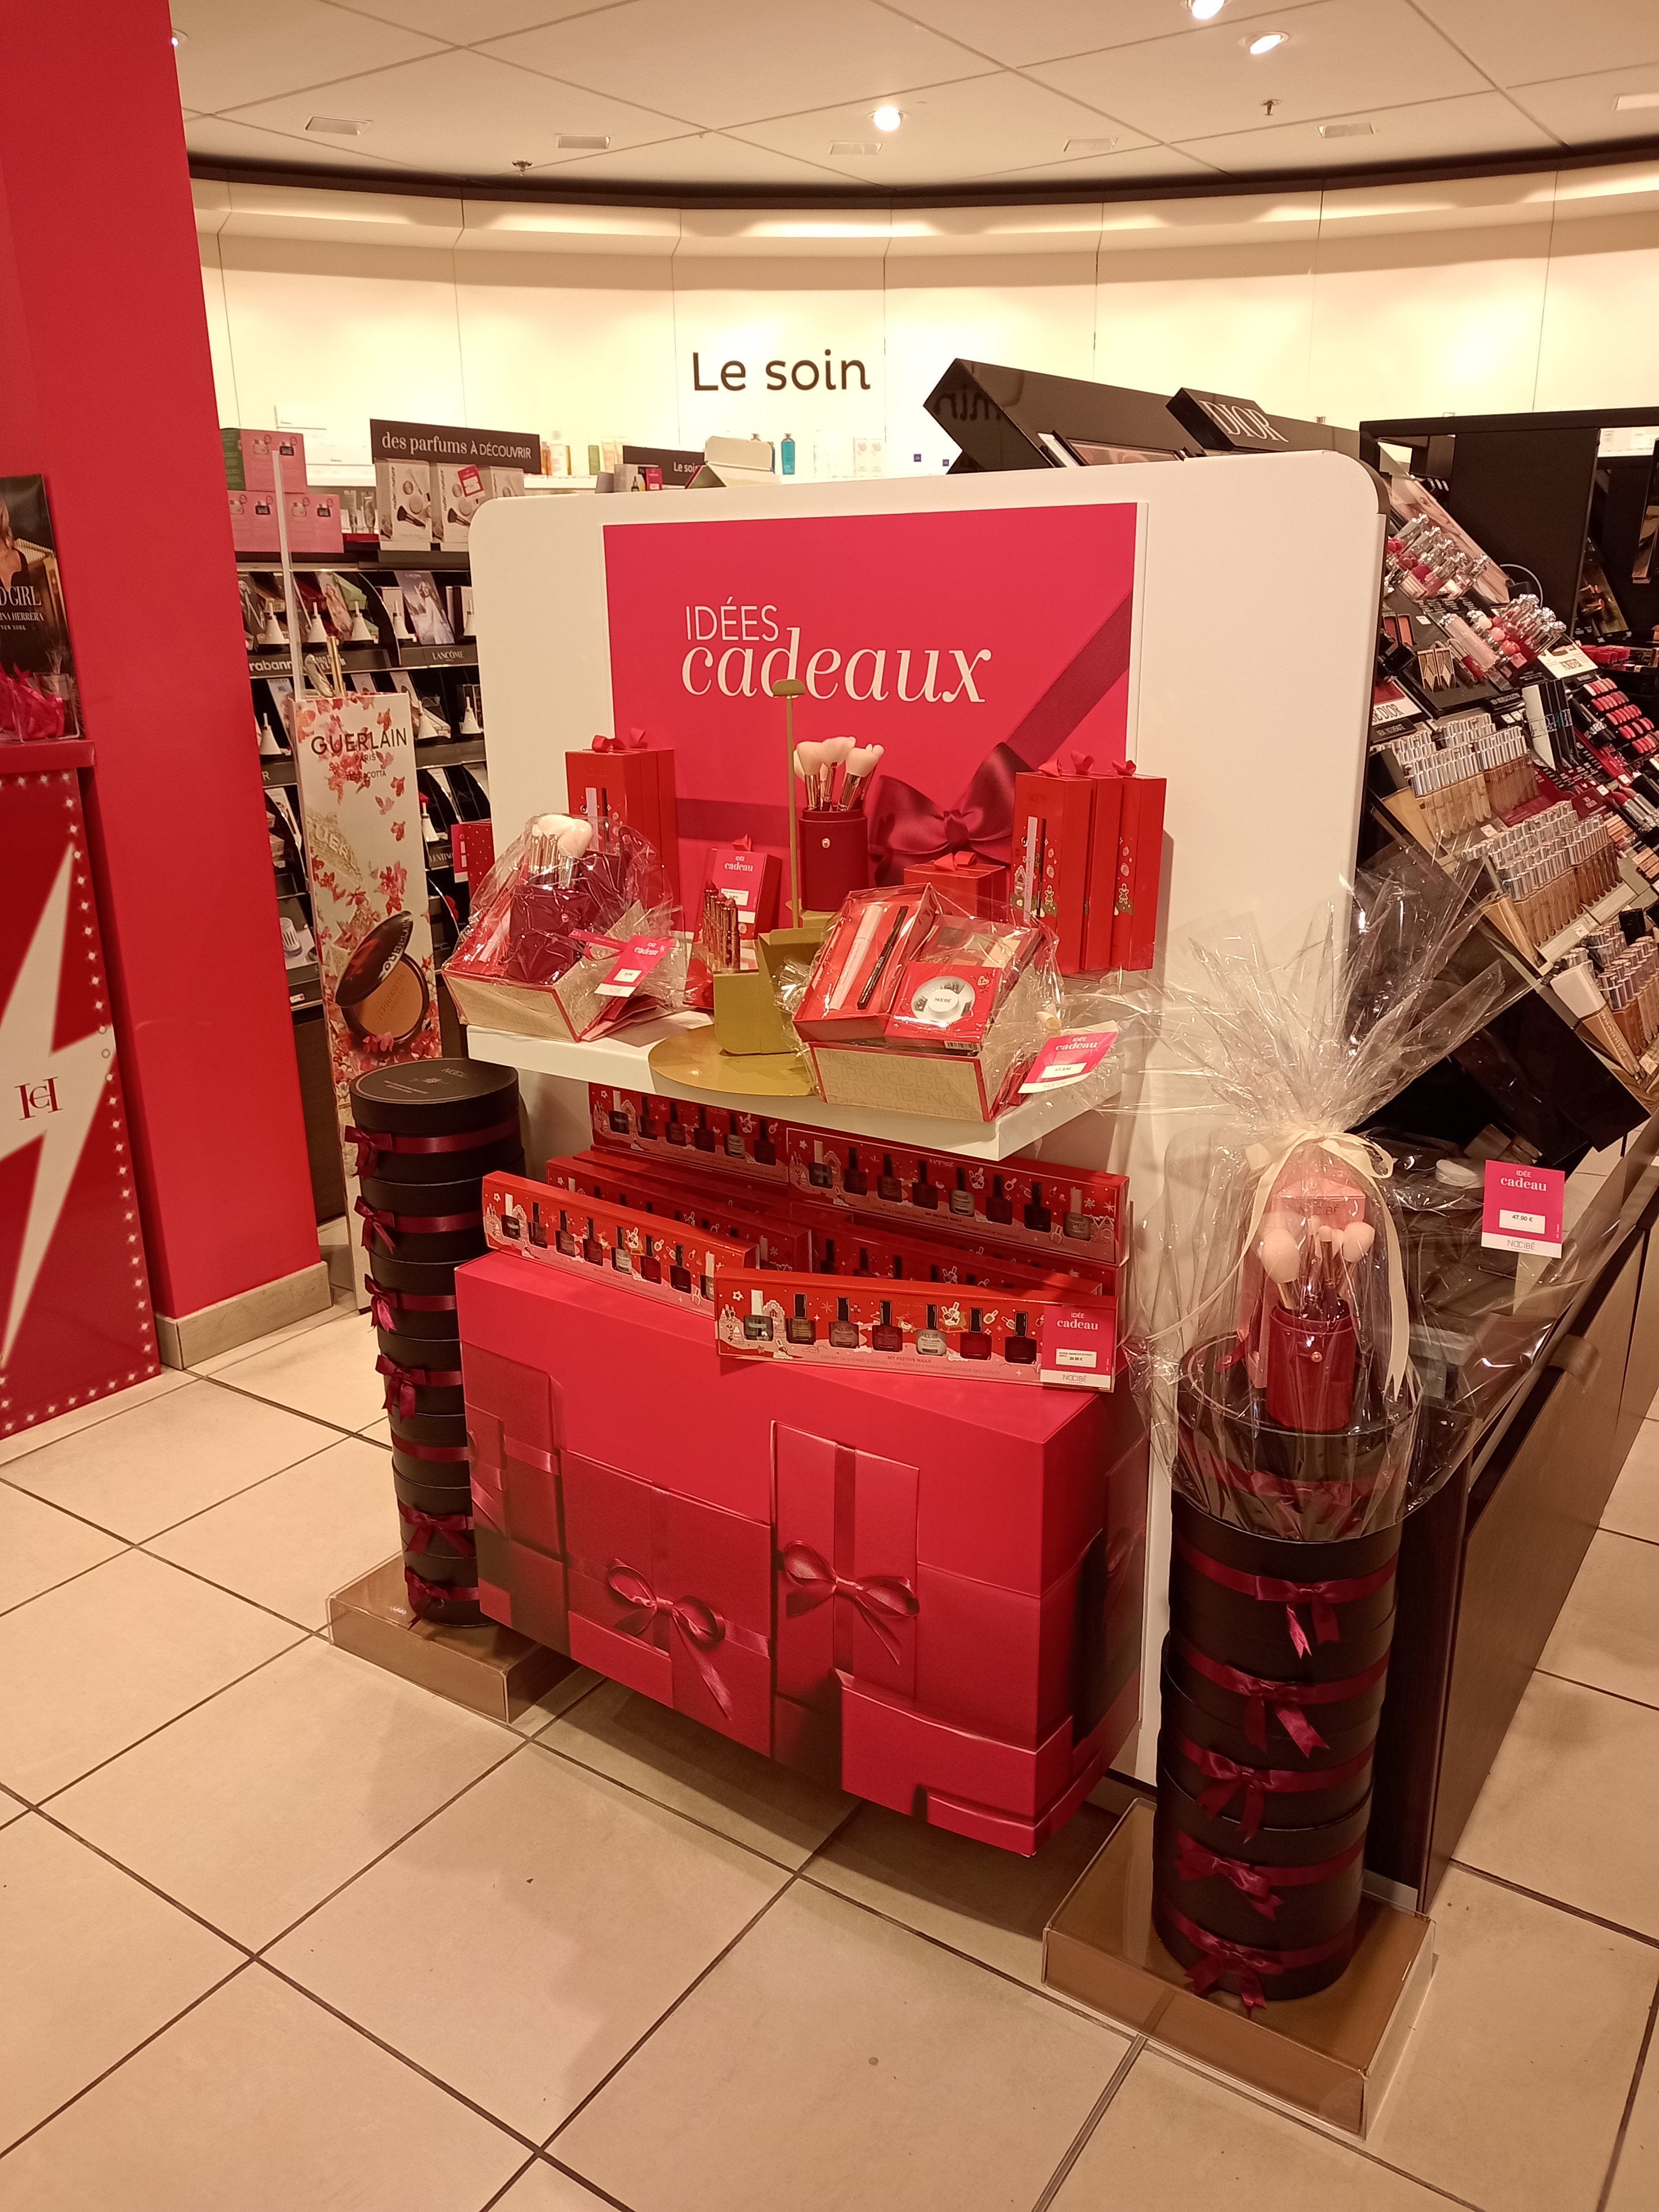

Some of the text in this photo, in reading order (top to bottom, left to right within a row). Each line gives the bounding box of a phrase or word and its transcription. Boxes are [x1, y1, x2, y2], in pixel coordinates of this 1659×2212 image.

[693, 349, 870, 392] Le soin
[1198, 400, 1289, 442] DIOR
[382, 431, 532, 459] des parfums À DÉCOUVRIR
[674, 461, 683, 472] Le
[8, 586, 42, 606] GIRL
[12, 612, 45, 621] HERRERA
[685, 596, 779, 641] IDÉES
[681, 627, 992, 703] cadeaux
[1376, 703, 1404, 719] DIOR
[310, 727, 407, 755] GUERLAIN
[355, 753, 376, 761] PARIS
[346, 770, 387, 781] TERRACOTTA
[724, 862, 753, 872] cadeau
[634, 946, 660, 956] cadeau
[1055, 1041, 1098, 1051] cadeau
[1500, 1177, 1547, 1192] cadeau
[1507, 1239, 1535, 1250] NOCIBÉ
[1057, 1318, 1098, 1331] cadeau
[1062, 1374, 1087, 1383] NOCIBÉ
